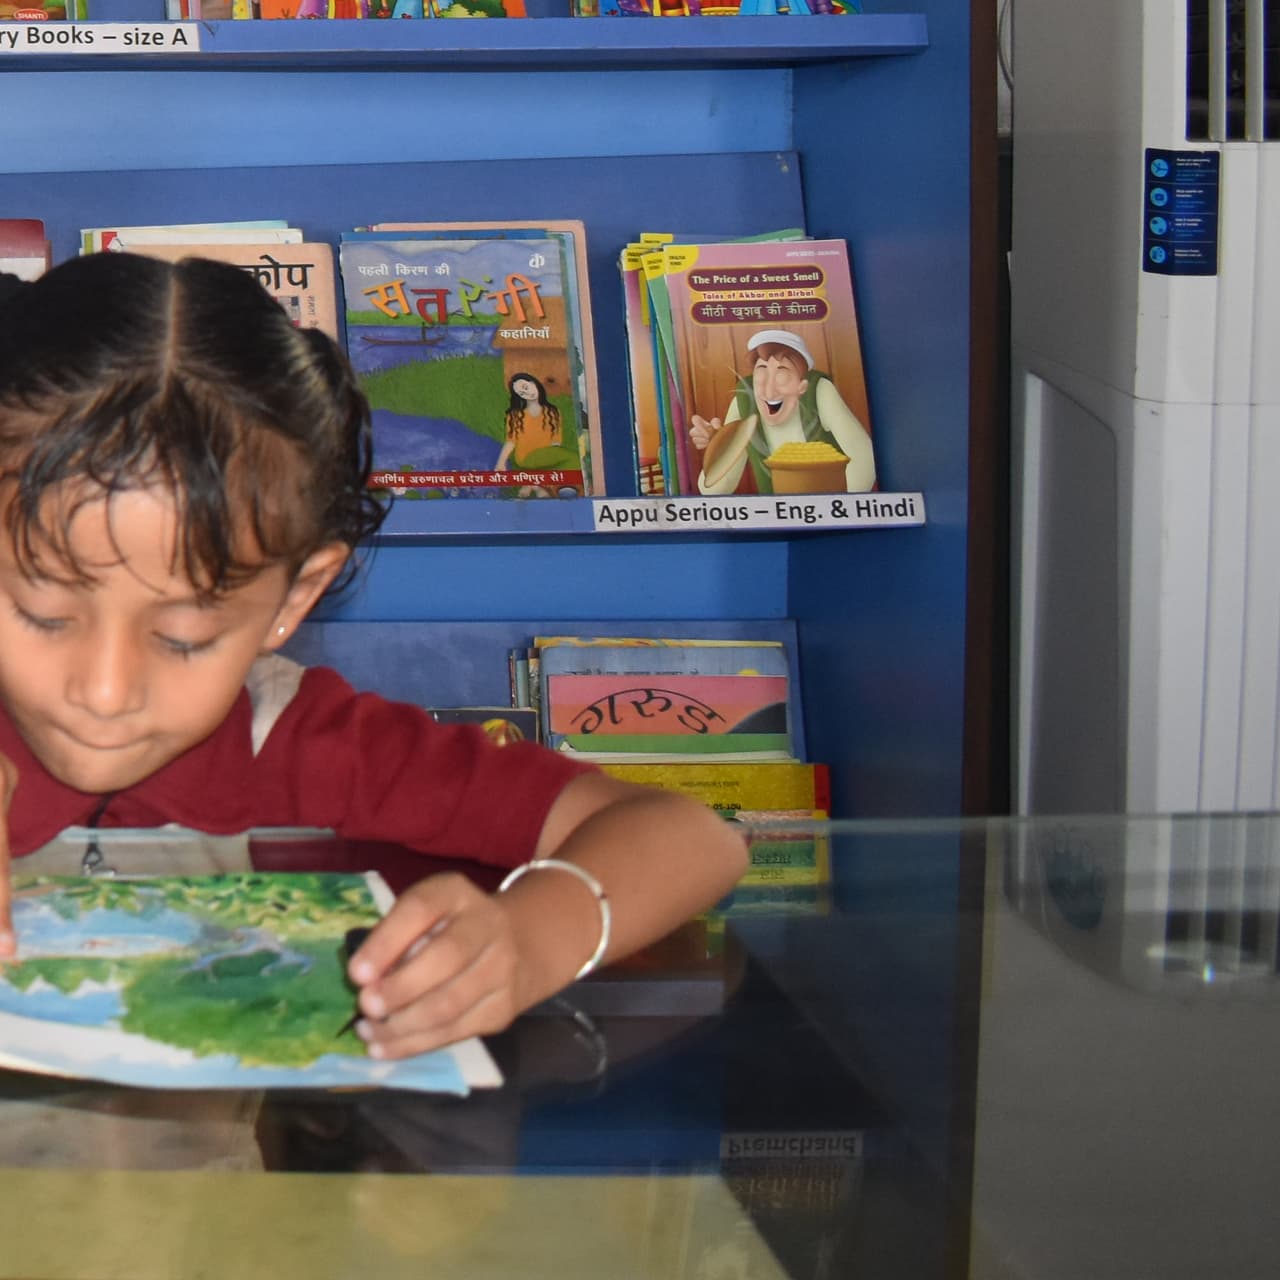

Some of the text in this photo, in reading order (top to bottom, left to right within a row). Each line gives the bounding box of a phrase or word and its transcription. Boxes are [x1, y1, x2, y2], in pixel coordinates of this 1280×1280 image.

[26, 27, 95, 45] Books
[122, 28, 166, 46] size
[171, 28, 189, 46] A
[692, 272, 819, 285] The Price of a Sweet Smell
[361, 272, 546, 324] सतरंगी
[598, 499, 915, 525] Appu Serious Eng. & Hindi
